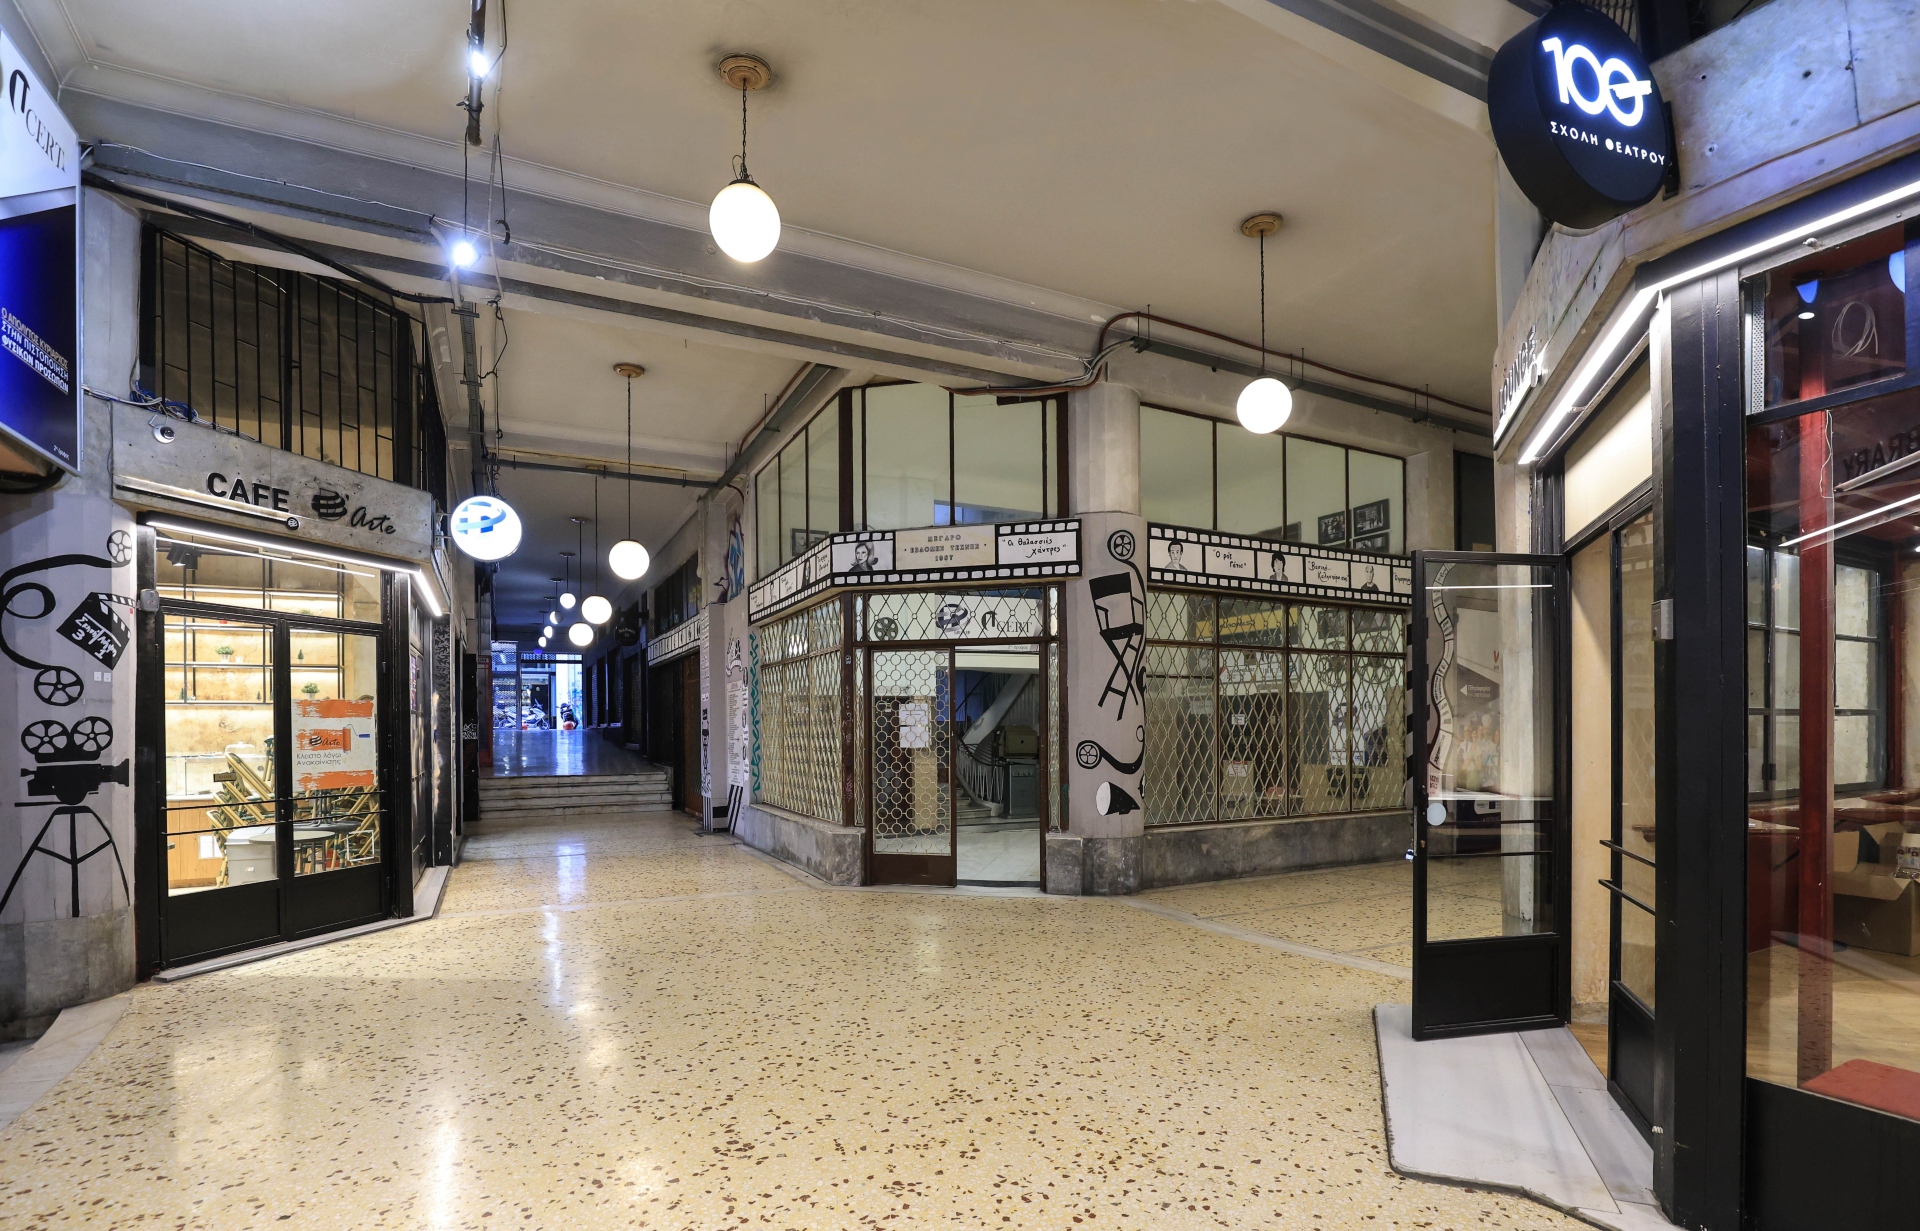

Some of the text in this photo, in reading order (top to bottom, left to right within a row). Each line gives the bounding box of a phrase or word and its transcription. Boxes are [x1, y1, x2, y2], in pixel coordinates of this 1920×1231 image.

[1550, 121, 1665, 166] ΣΧΟΛΗ ΘΕΑΤΡΟΥ
[8, 313, 39, 345] ΑΠΟΛΥΤΟΣ
[1, 320, 69, 381] ΣΤΗΝ ΠΙΣΤΟΠΟΙΗΣΗ
[1, 334, 69, 393] ΦΥΣΙΚΩΝ ΠΡΟΣΩΠΩΝ
[206, 472, 290, 514] CAFE
[927, 534, 962, 542] ΜΕΓΑΡΟ
[71, 628, 85, 641] 3
[296, 752, 342, 761] Κλειστό λόγω
